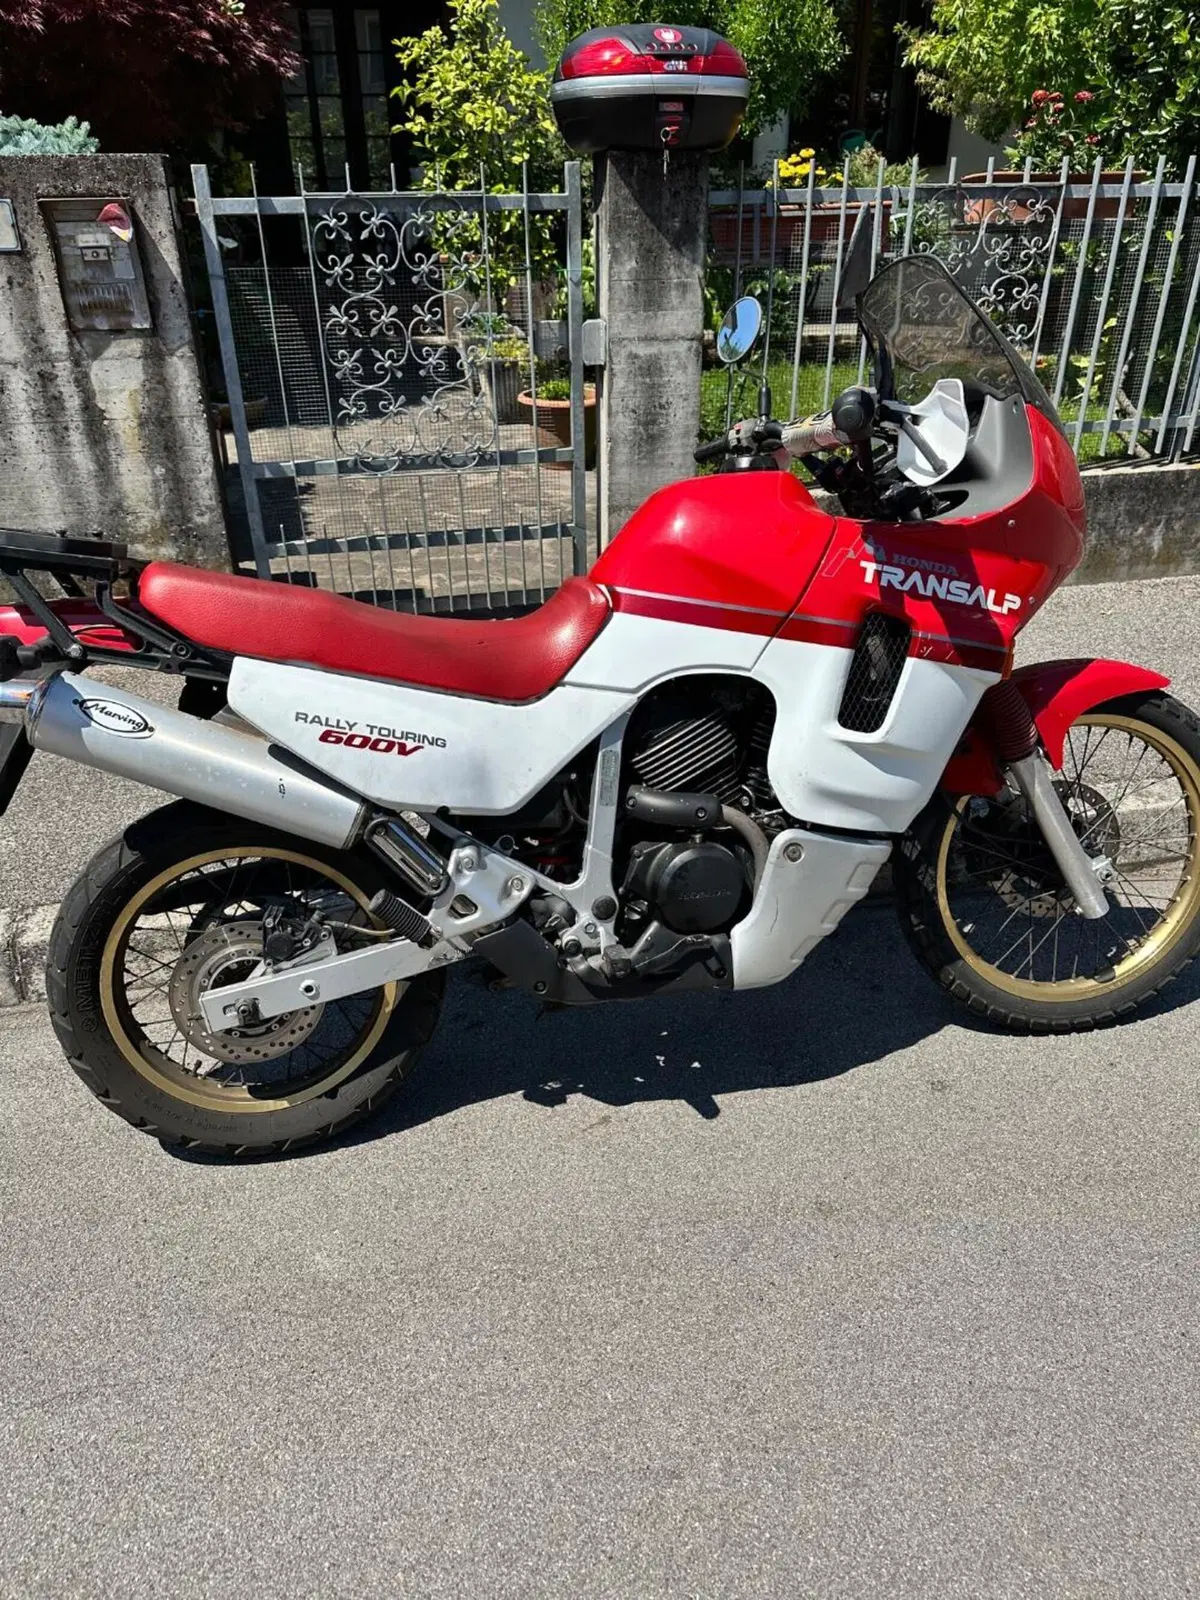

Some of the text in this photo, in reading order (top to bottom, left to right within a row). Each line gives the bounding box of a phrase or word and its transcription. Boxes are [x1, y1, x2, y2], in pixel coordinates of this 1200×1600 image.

[892, 553, 959, 577] HONDA
[859, 560, 1021, 615] TRANSALP
[83, 702, 143, 731] Marving
[295, 711, 447, 748] RALLY TOURING
[318, 729, 424, 757] 600V
